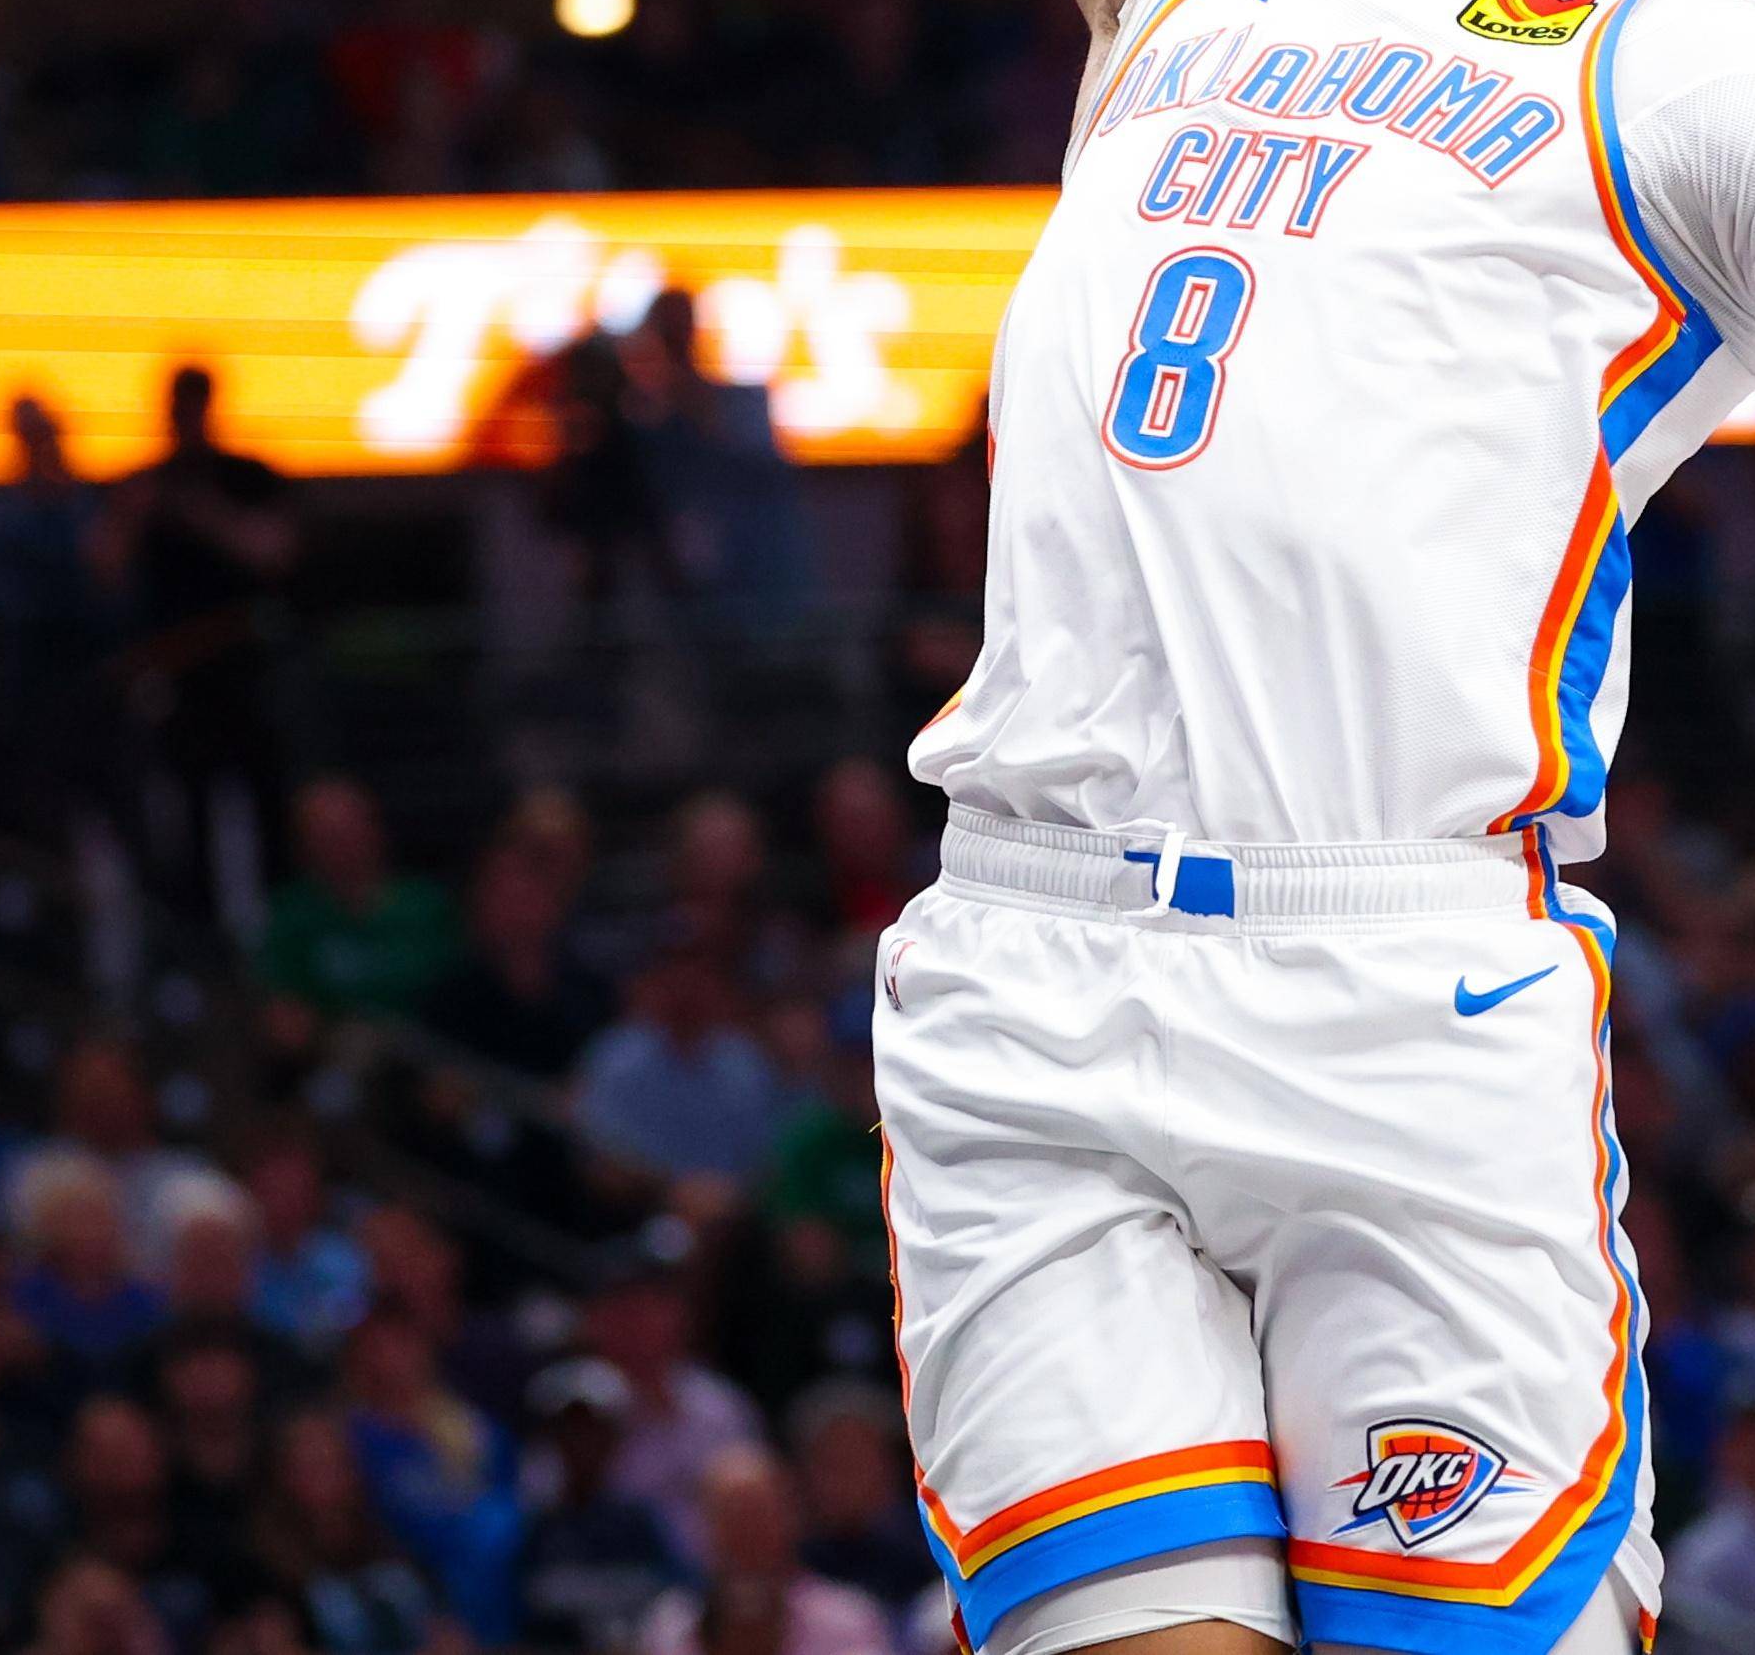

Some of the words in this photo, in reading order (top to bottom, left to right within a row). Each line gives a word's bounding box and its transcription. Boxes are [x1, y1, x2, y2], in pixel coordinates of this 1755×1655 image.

[1098, 23, 1566, 190] OKLAHOMA
[1137, 124, 1372, 240] CITY
[1101, 246, 1257, 472] 8
[1353, 1451, 1473, 1517] OKC
